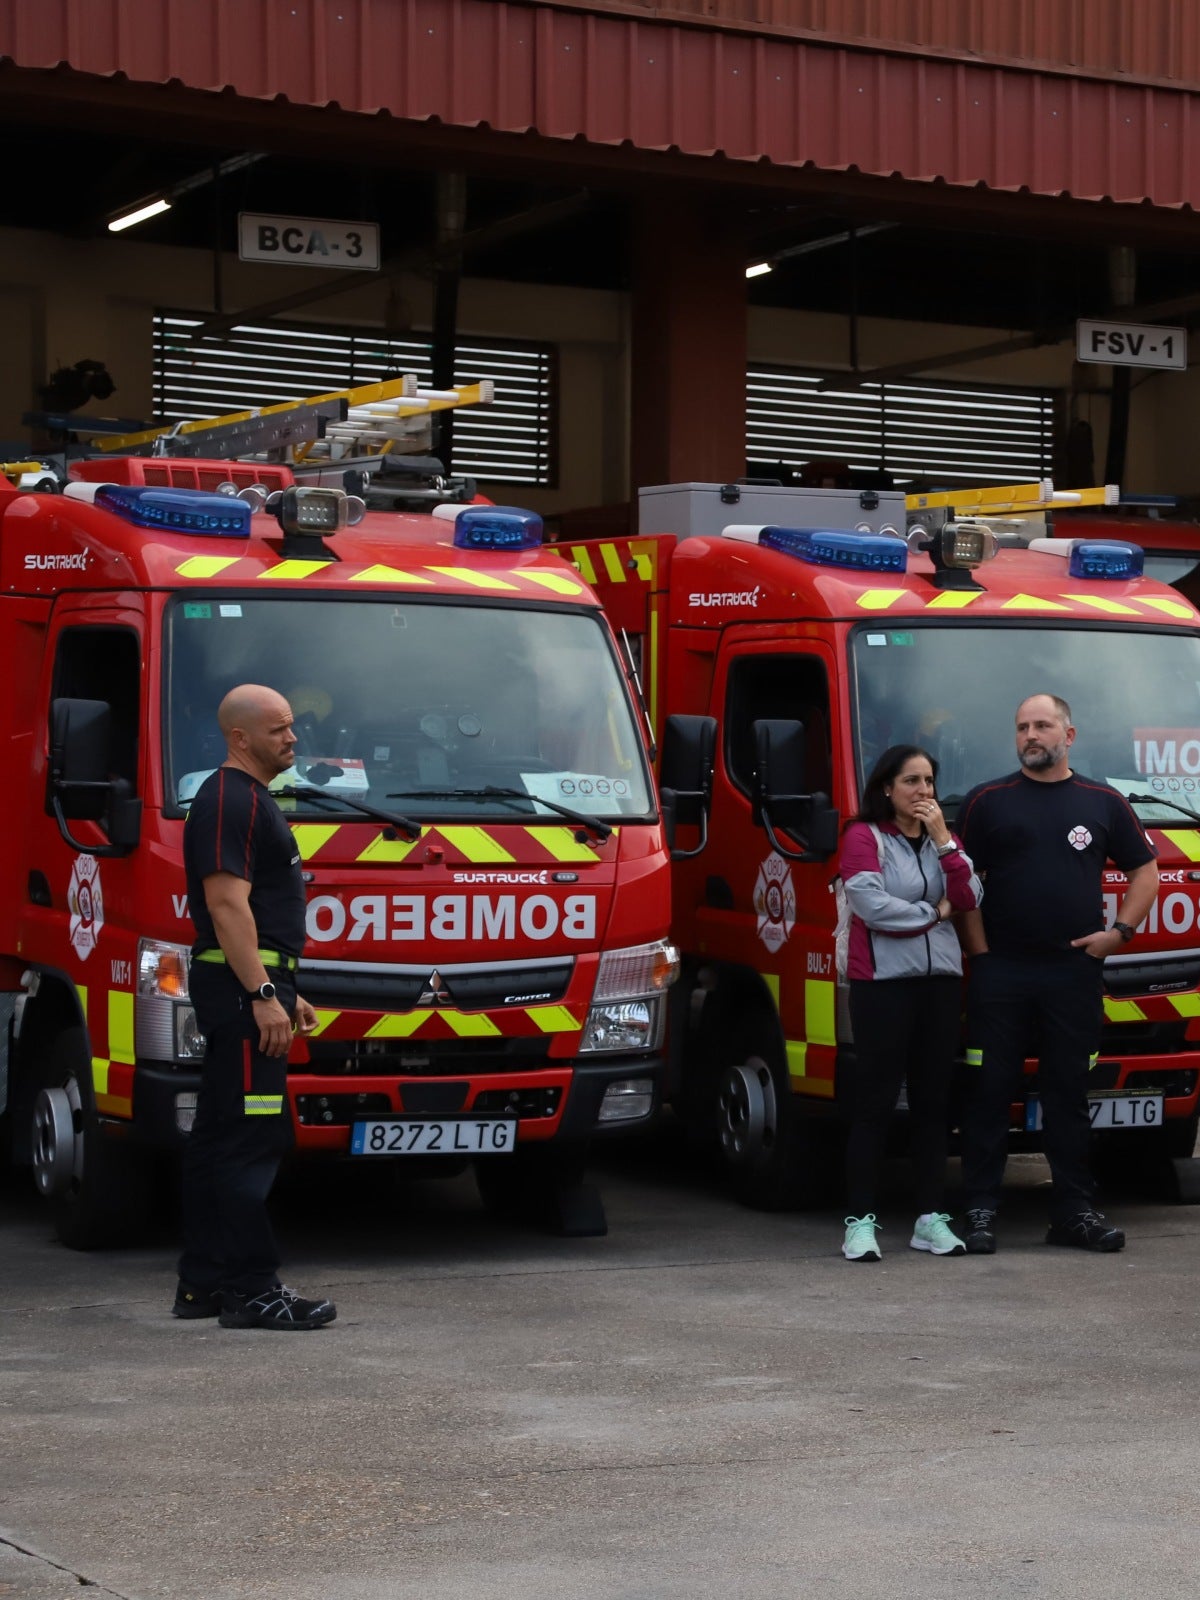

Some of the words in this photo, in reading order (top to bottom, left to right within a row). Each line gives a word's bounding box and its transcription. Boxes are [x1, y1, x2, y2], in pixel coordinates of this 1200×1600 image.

[24, 553, 84, 570] SURTRUCK
[689, 591, 754, 607] SURTRUCK
[453, 872, 539, 884] SURTRUCK
[112, 961, 131, 985] VAT-1
[807, 952, 832, 975] BUL-7
[1112, 1101, 1156, 1125] LTG
[370, 1125, 443, 1150] 8272
[454, 1123, 507, 1149] LTG
